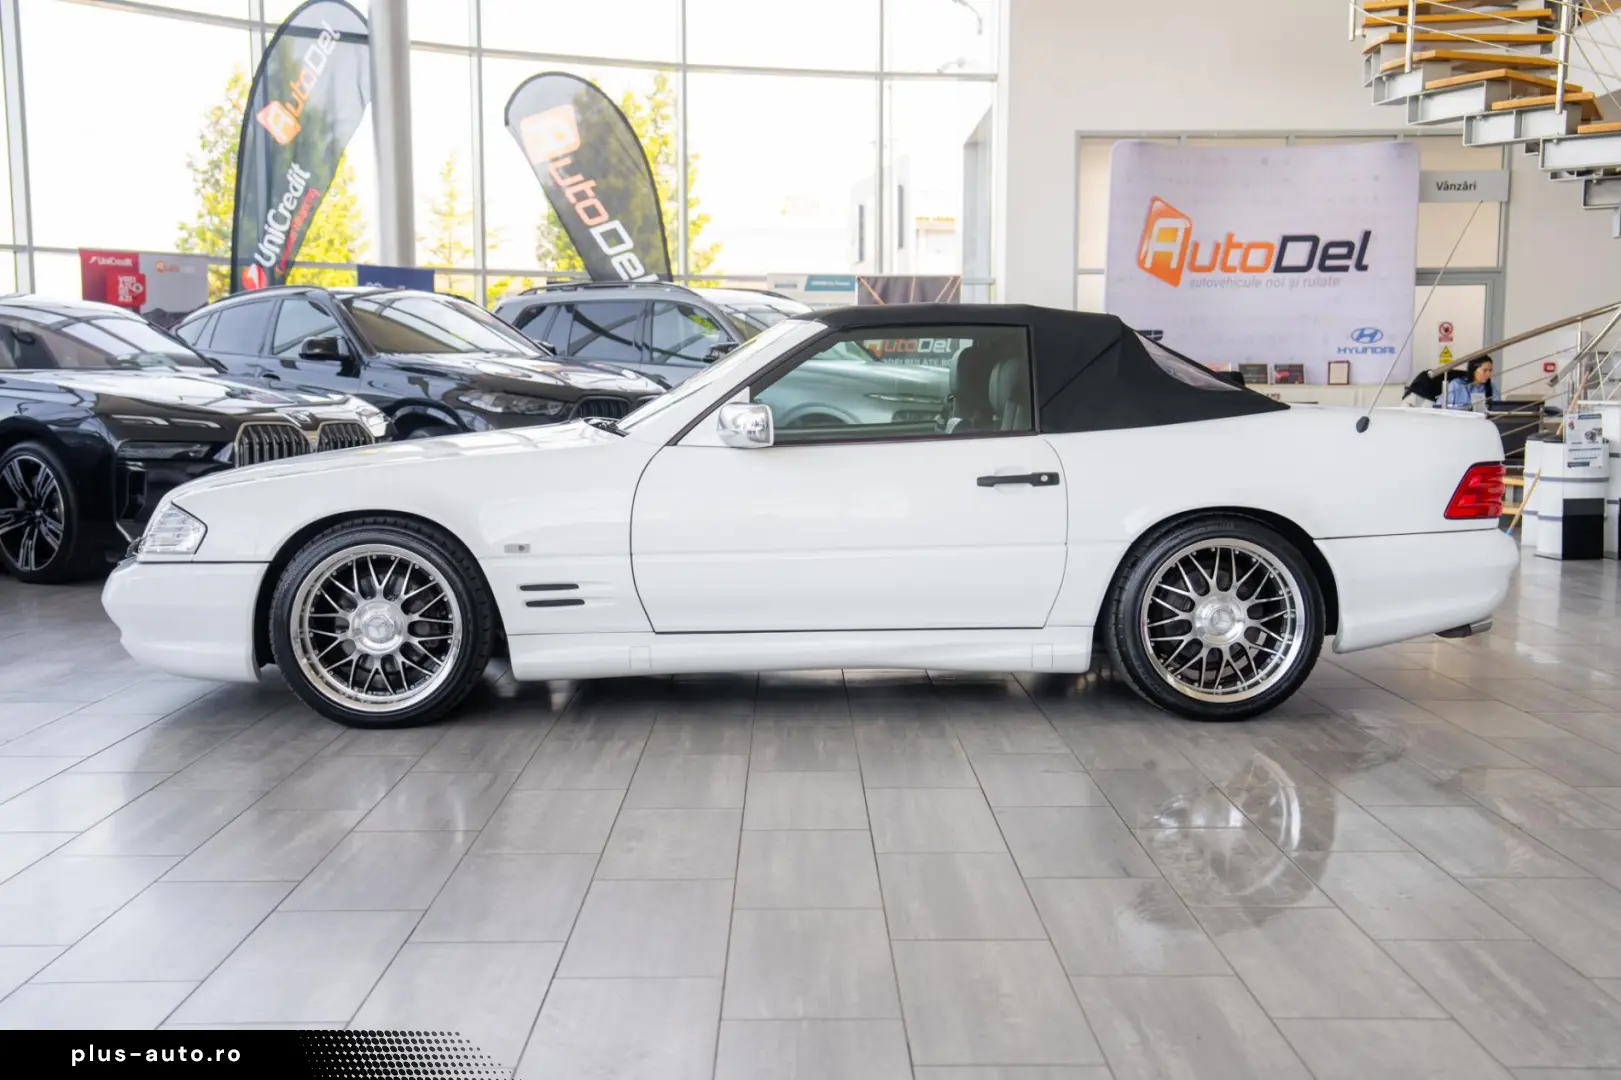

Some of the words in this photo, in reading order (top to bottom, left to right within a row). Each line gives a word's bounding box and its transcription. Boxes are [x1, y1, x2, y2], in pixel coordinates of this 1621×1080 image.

[253, 162, 311, 268] UniCredit
[1142, 214, 1372, 274] AutoDel
[1188, 276, 1262, 290] autovehicule
[1265, 276, 1285, 290] noi
[1337, 346, 1396, 354] HYUNDAI
